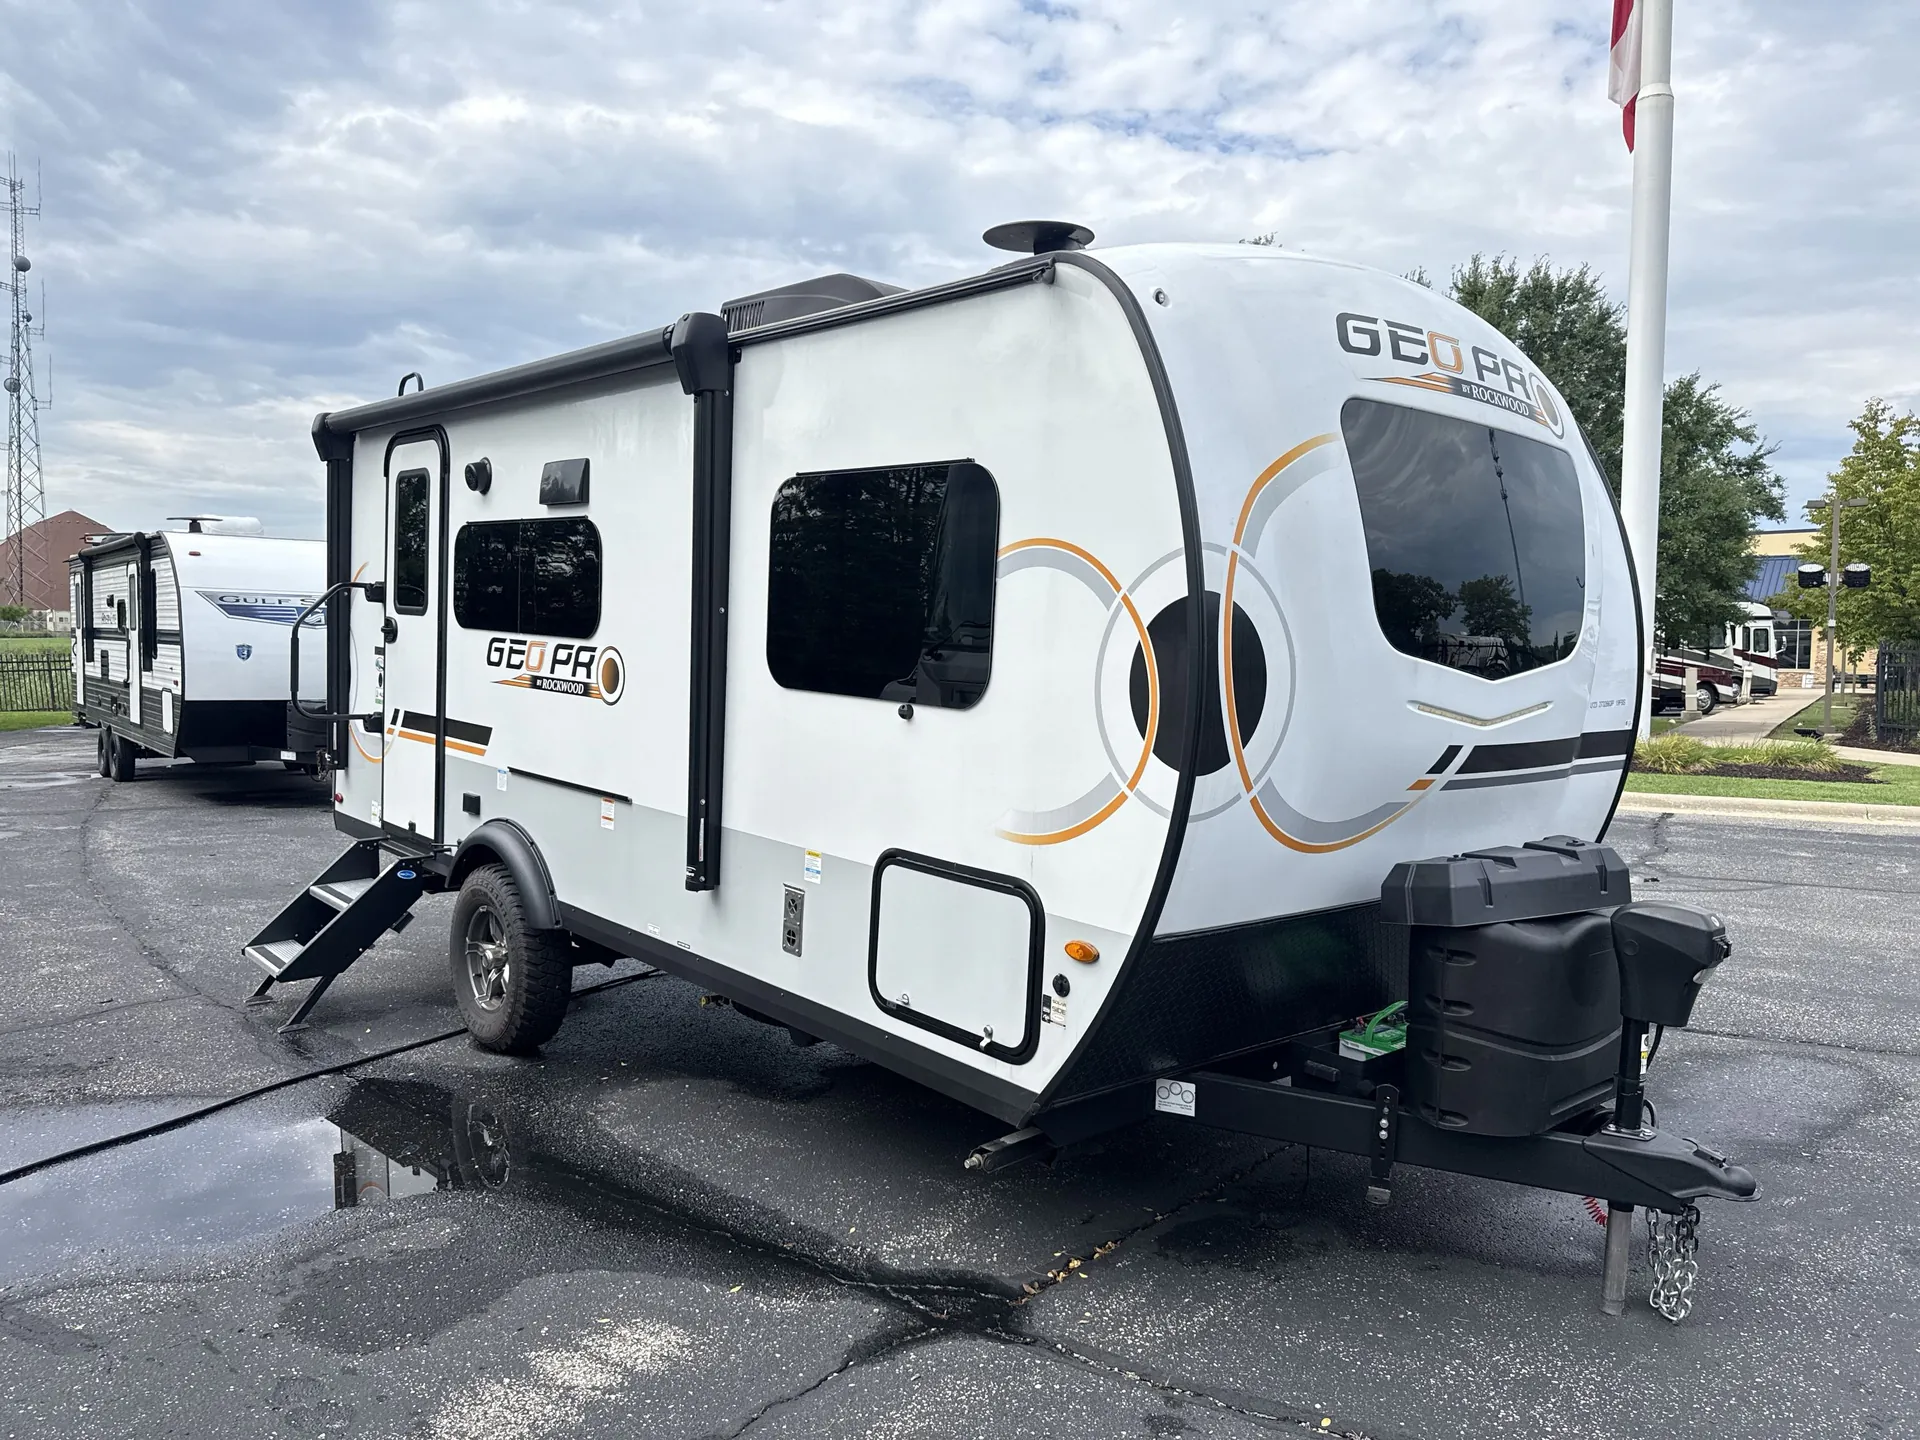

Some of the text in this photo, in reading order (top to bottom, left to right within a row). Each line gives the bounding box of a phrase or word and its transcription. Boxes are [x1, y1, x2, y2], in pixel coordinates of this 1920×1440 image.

[1335, 312, 1565, 440] GEO PRO
[1461, 383, 1530, 416] BY ROCKWOOD
[486, 637, 626, 706] GEO PRO
[541, 678, 585, 695] ROCKWOOD
